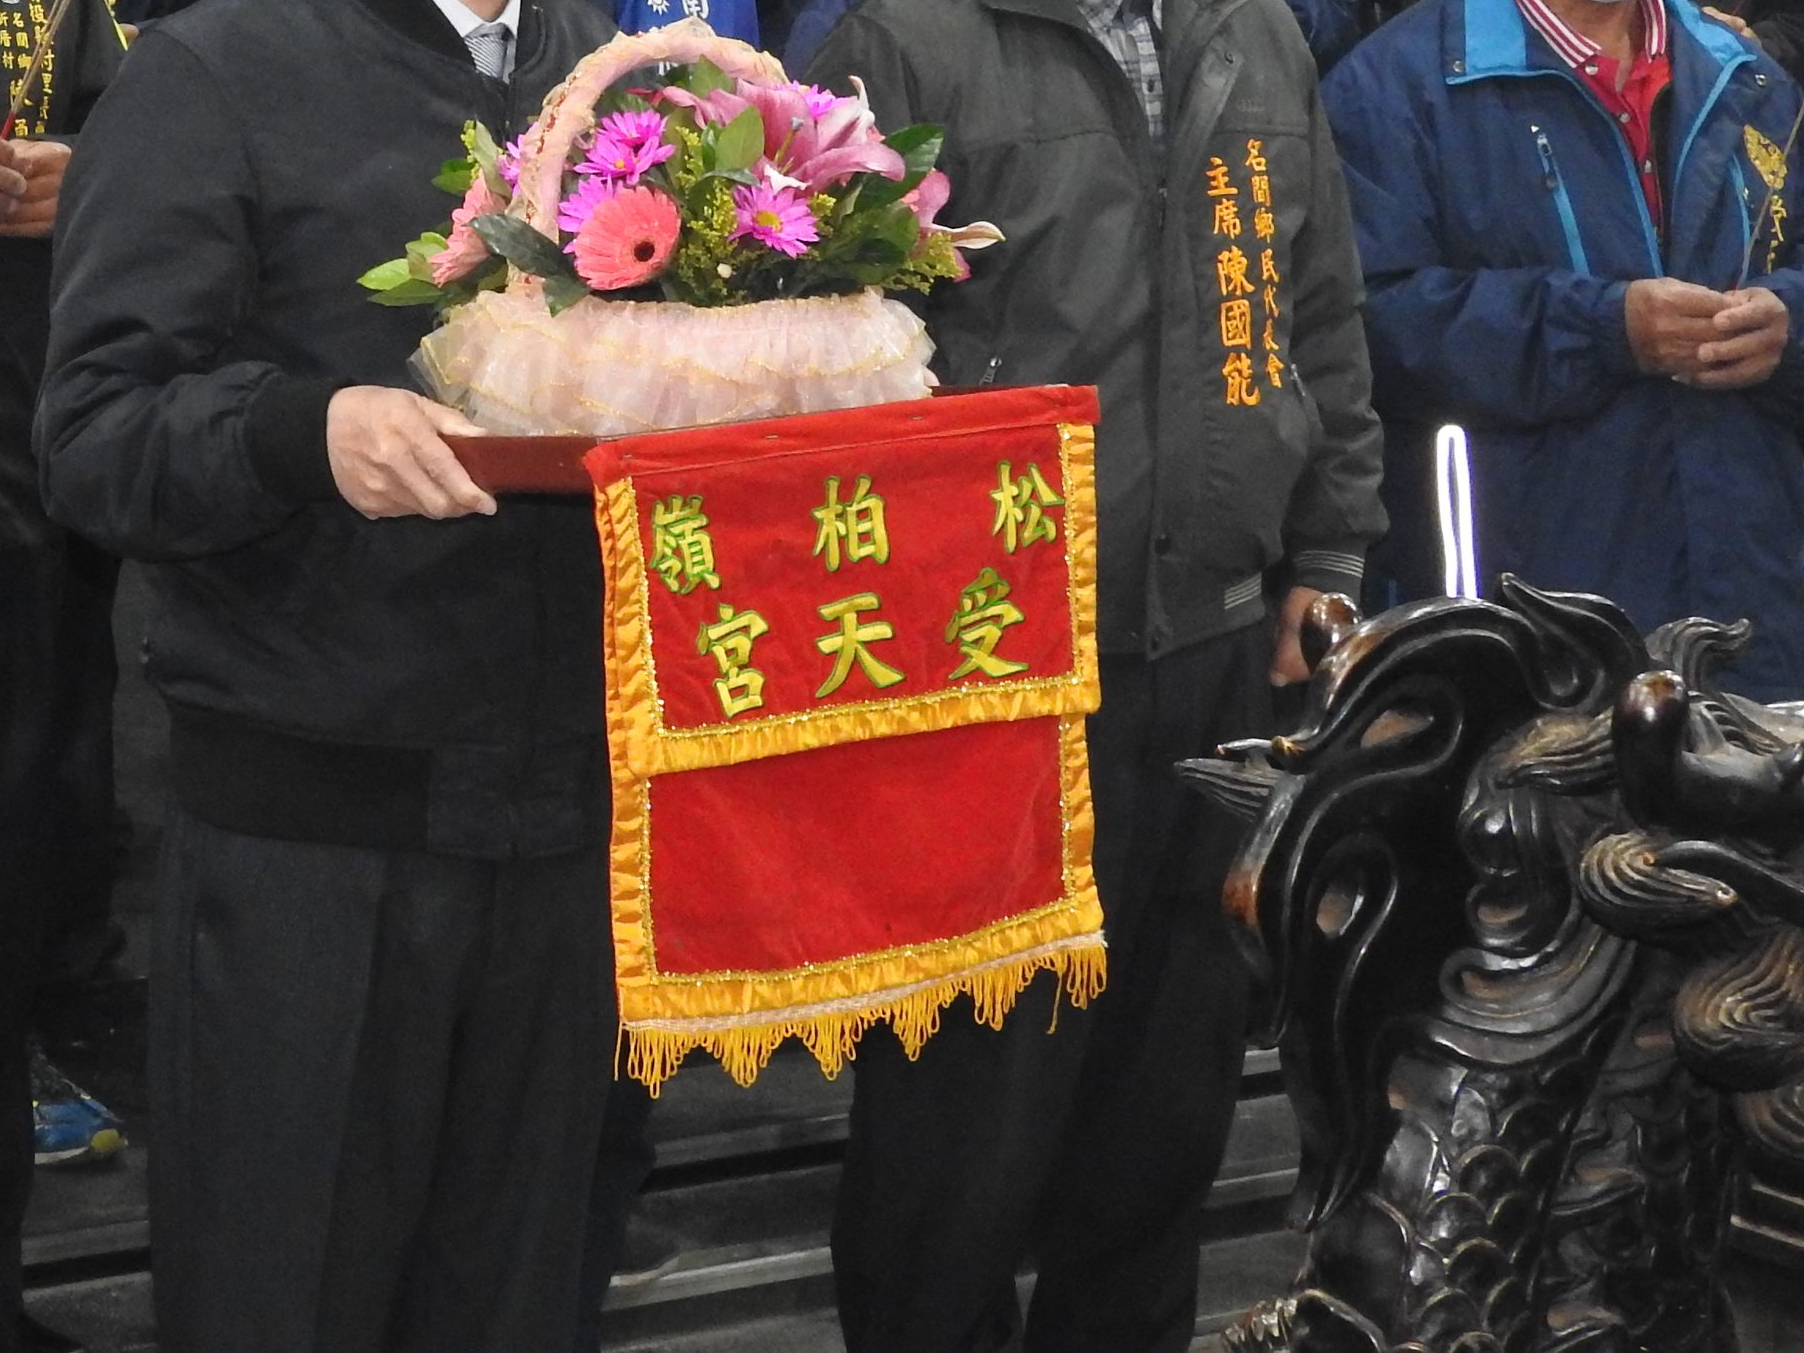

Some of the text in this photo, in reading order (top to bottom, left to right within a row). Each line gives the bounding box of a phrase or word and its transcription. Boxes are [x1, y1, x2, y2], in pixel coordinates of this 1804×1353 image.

[1245, 137, 1285, 389] 名間鄉民代表會
[647, 459, 1067, 596] 松柏嶺
[695, 566, 1031, 720] 受天宮
